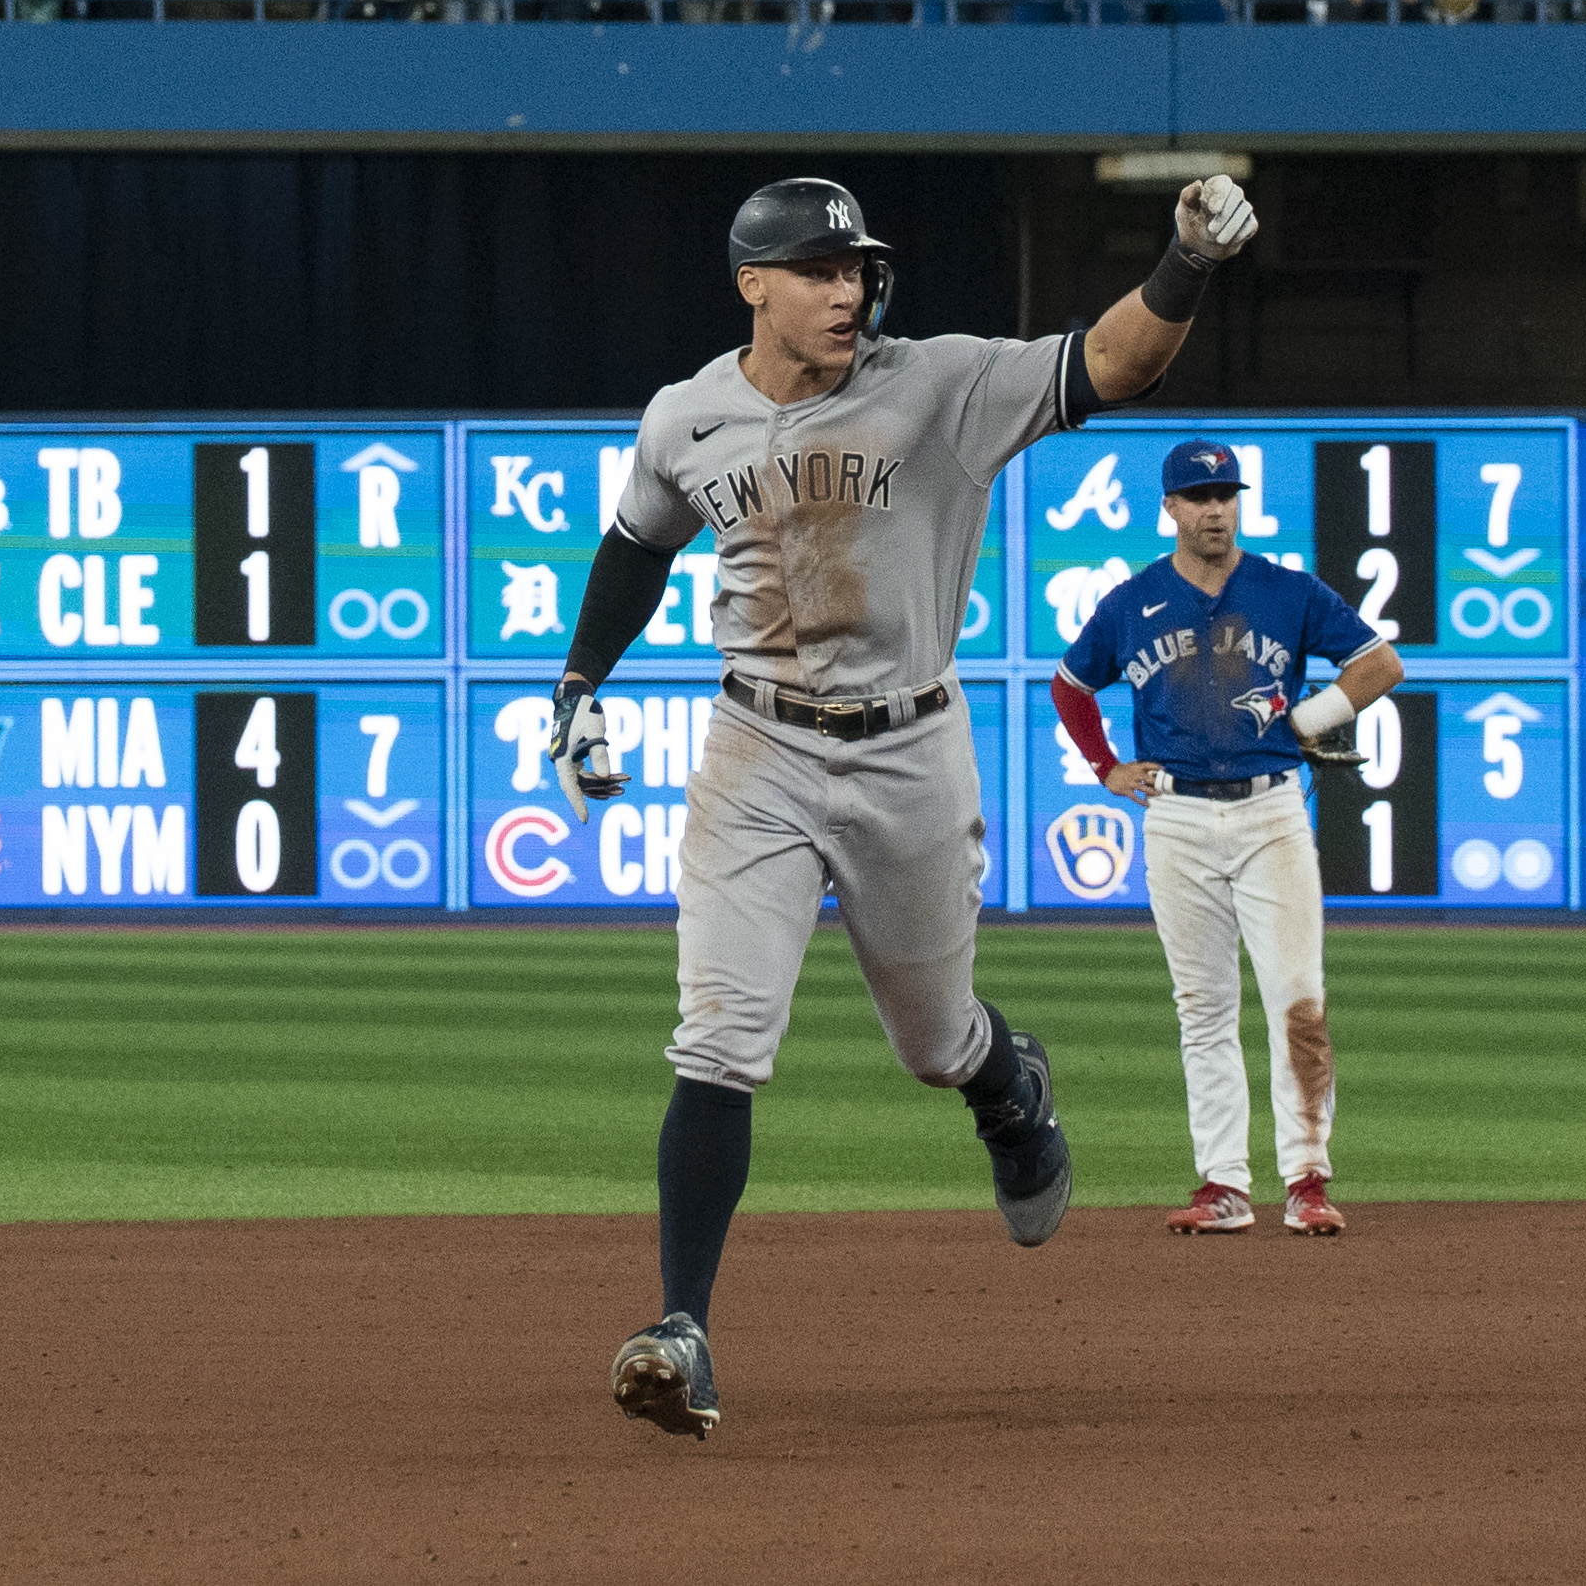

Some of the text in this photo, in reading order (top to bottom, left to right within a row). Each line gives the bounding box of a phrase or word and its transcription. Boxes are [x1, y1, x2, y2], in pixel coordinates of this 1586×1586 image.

[38, 447, 400, 548] TB 1 R
[688, 464, 765, 537] NEW
[775, 449, 904, 512] YORK
[1360, 445, 1390, 536] 1
[1480, 463, 1522, 547] 7
[38, 551, 269, 647] CLE 1
[1356, 548, 1400, 641] 2
[1126, 626, 1291, 690] BLUE JAYS
[41, 697, 400, 797] MIA 4 7
[1355, 694, 1524, 799] 0 5
[41, 800, 281, 896] NYM 0
[599, 803, 689, 896] CH
[1362, 800, 1393, 892] 1
